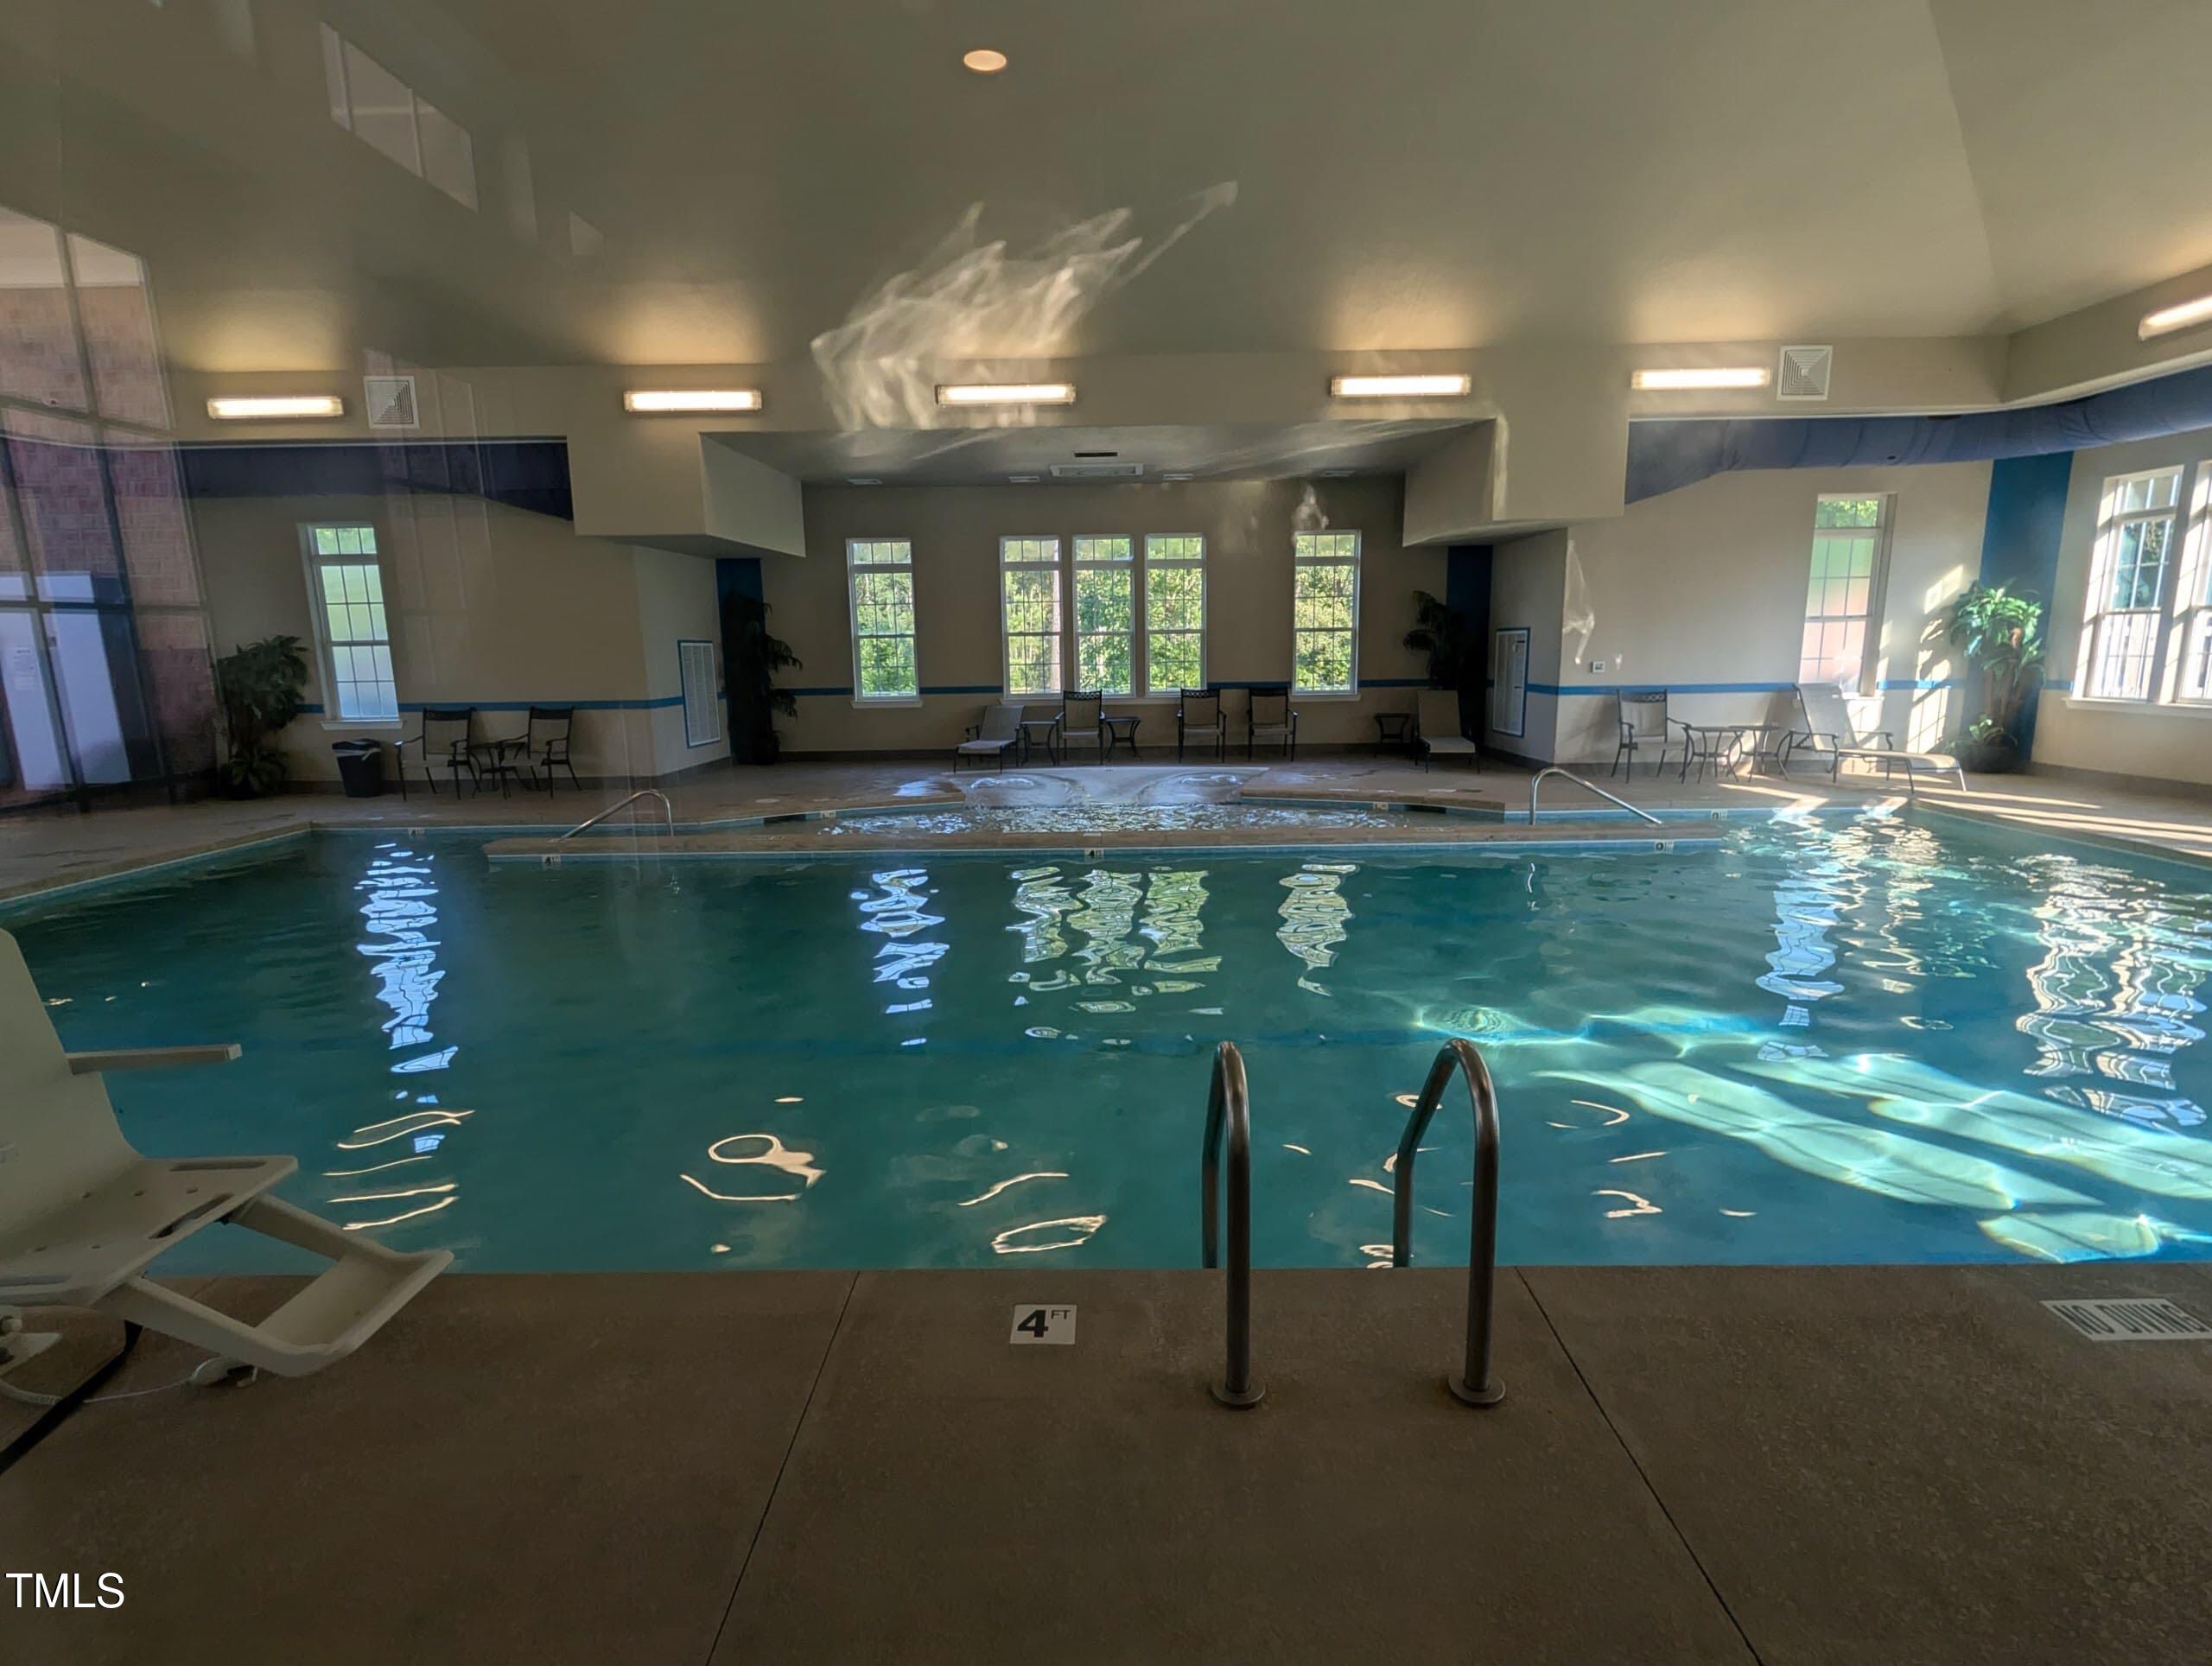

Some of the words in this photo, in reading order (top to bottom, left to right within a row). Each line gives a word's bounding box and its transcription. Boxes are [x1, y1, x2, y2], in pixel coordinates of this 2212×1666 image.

[1017, 1309, 1049, 1338] 4
[1051, 1309, 1071, 1319] FT
[2052, 1305, 2116, 1334] NO
[2094, 1304, 2210, 1333] DIVING
